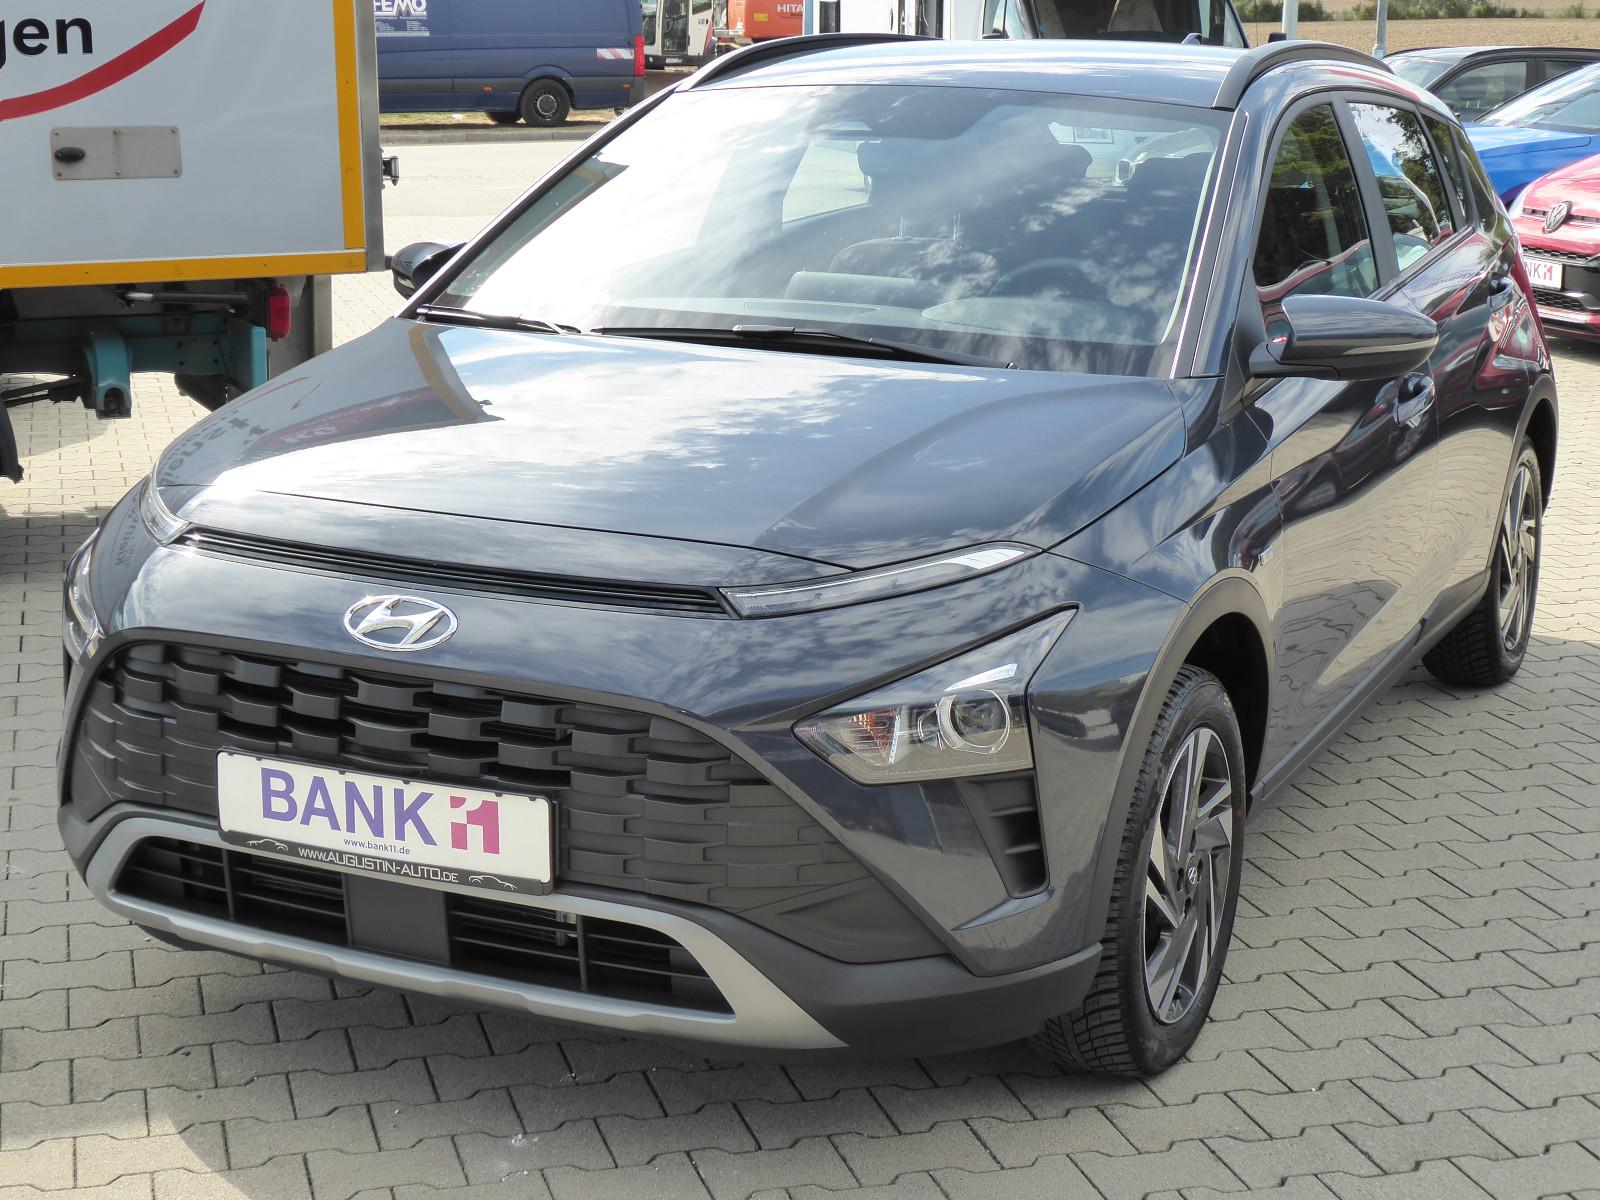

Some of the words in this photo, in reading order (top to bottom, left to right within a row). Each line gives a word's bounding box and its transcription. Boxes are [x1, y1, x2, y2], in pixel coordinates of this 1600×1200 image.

[0, 17, 93, 70] en
[260, 766, 438, 847] BANK
[343, 838, 411, 855] www.bank11.de
